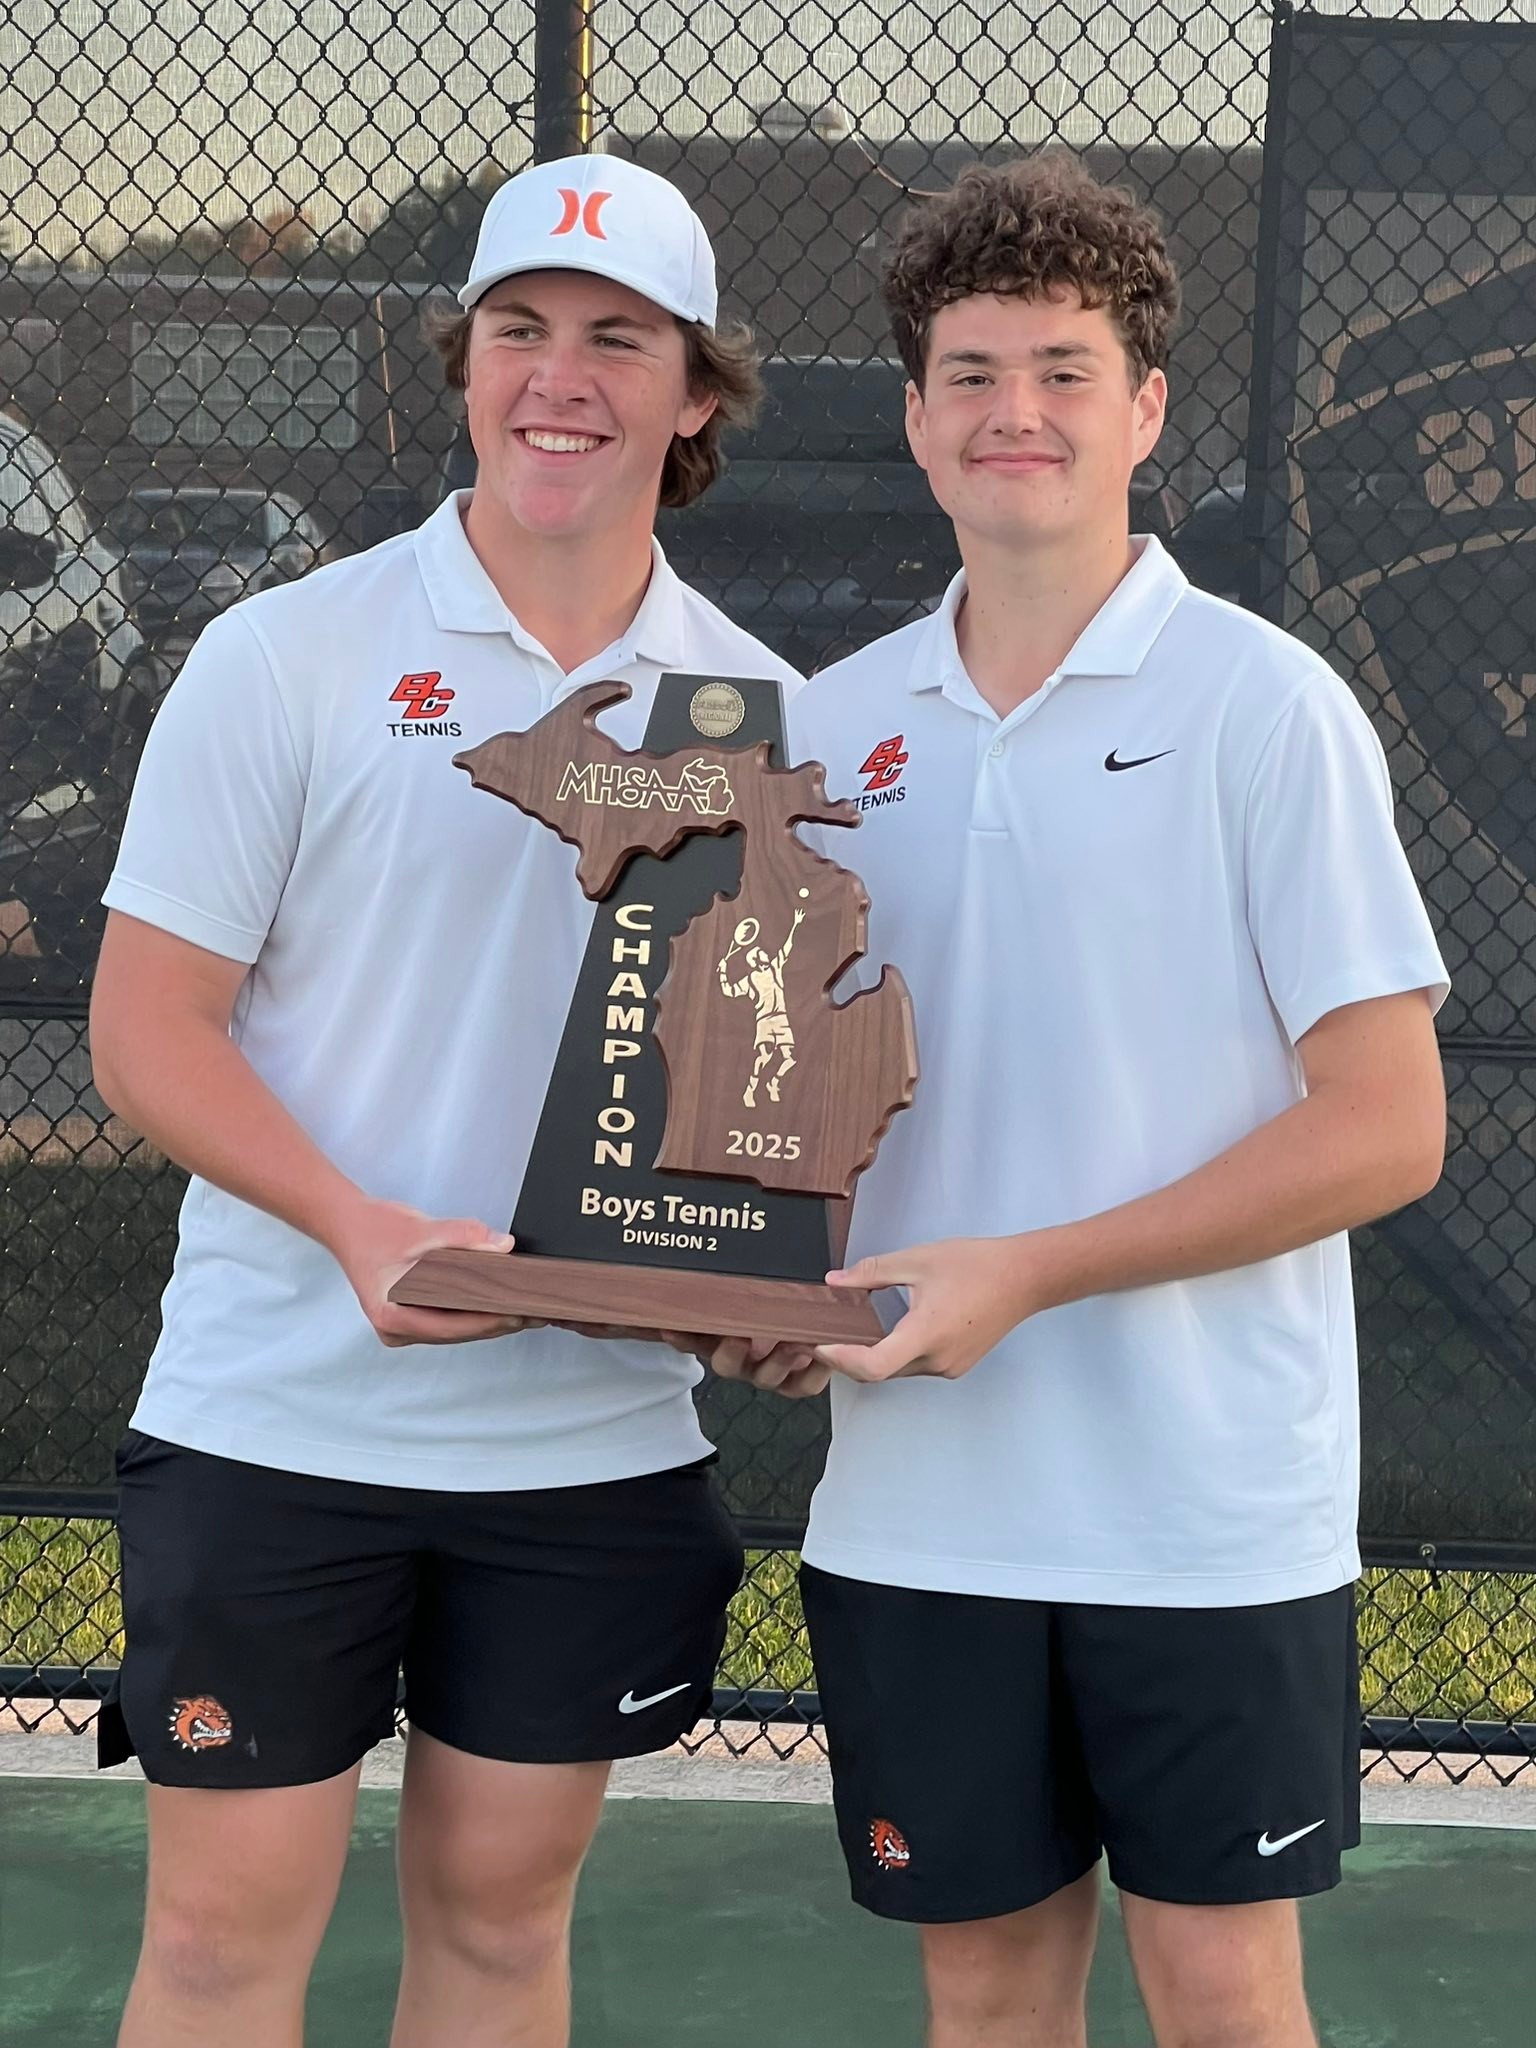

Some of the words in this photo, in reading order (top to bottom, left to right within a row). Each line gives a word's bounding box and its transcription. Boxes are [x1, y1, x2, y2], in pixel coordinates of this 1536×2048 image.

[388, 671, 455, 719] BC
[386, 722, 462, 737] TENNIS
[858, 734, 909, 791] BC
[556, 760, 709, 814] MHSAA
[852, 786, 906, 811] TENNIS
[593, 903, 654, 1168] CHAMPION
[725, 1130, 801, 1161] 2025
[580, 1187, 656, 1226] Boys
[662, 1195, 766, 1231] Tennis
[622, 1228, 703, 1250] DIVISION
[706, 1236, 718, 1252] 2
